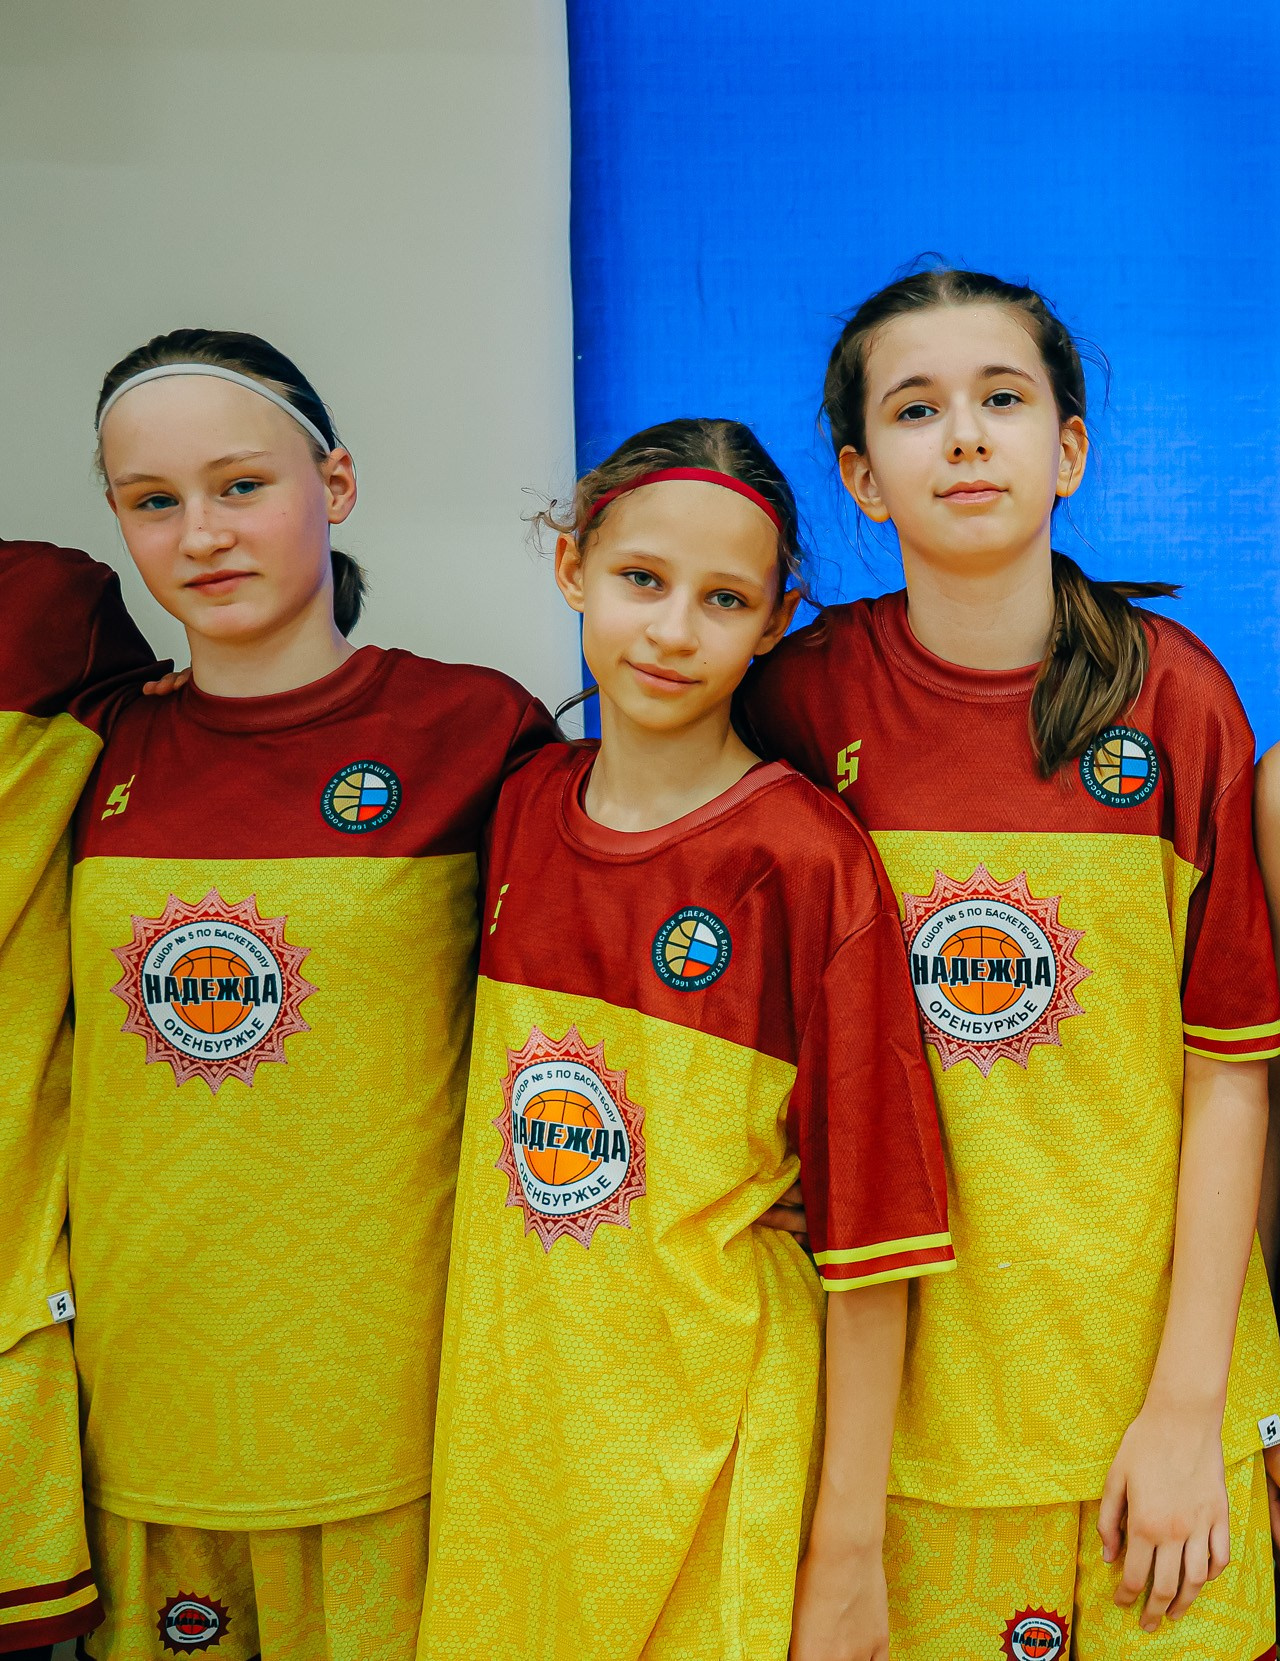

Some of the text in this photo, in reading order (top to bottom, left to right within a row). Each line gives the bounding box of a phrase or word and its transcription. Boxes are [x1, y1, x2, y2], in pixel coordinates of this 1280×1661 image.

[1099, 729, 1149, 747] ЕДЕРАЦИЯ
[152, 942, 174, 969] СШОР
[188, 931, 194, 940] 5
[196, 928, 211, 937] ПО
[214, 928, 270, 968] БАСКЕТБОЛУ
[922, 921, 944, 949] СШОР
[958, 910, 965, 919] 5
[967, 908, 982, 917] ПО
[985, 908, 1043, 951] БАСКЕТБОЛУ
[144, 973, 278, 1006] НАДЕЖДА
[912, 953, 1051, 989] НАДЕЖДА
[163, 1017, 265, 1053] ОРЕНБУРЖЬЕ
[929, 1000, 1038, 1034] ОРЕНБУРЖЬЕ
[514, 1079, 529, 1107] СШОР
[555, 1070, 571, 1079] ПО
[574, 1071, 617, 1123] БАСКЕТБОЛУ
[512, 1110, 626, 1163] НАДЕЖДА
[519, 1162, 612, 1207] ОРЕНБУРЖЬЕ
